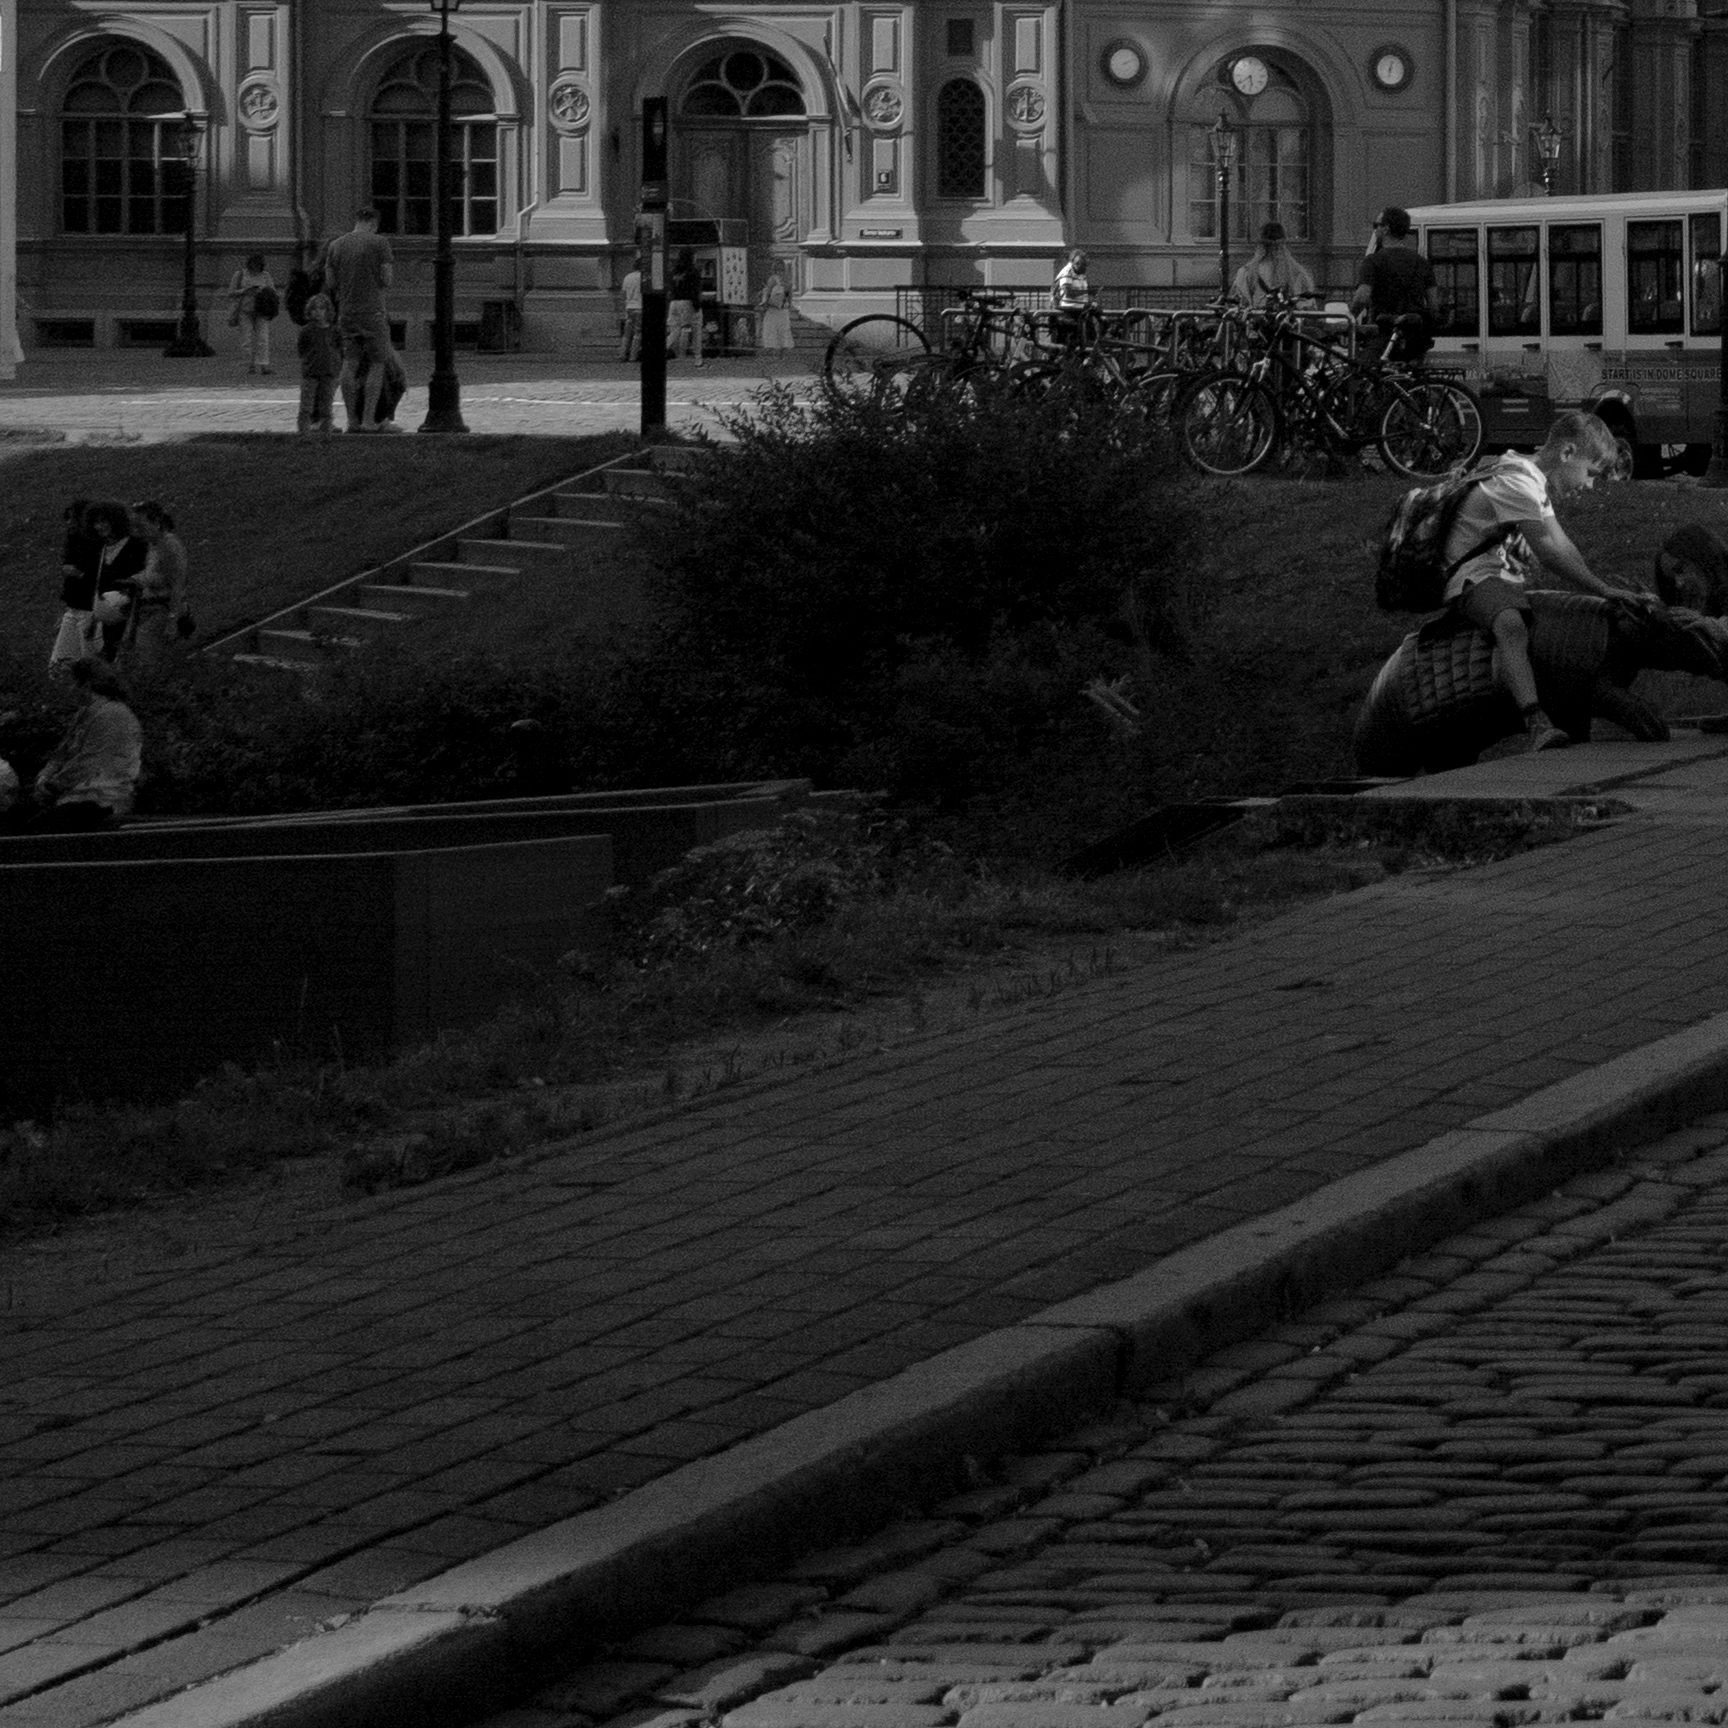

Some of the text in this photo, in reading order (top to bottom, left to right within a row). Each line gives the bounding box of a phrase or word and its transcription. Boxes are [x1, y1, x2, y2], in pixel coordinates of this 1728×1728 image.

[880, 173, 887, 183] 6
[1602, 369, 1722, 380] START IS IN DOME SQUARE
